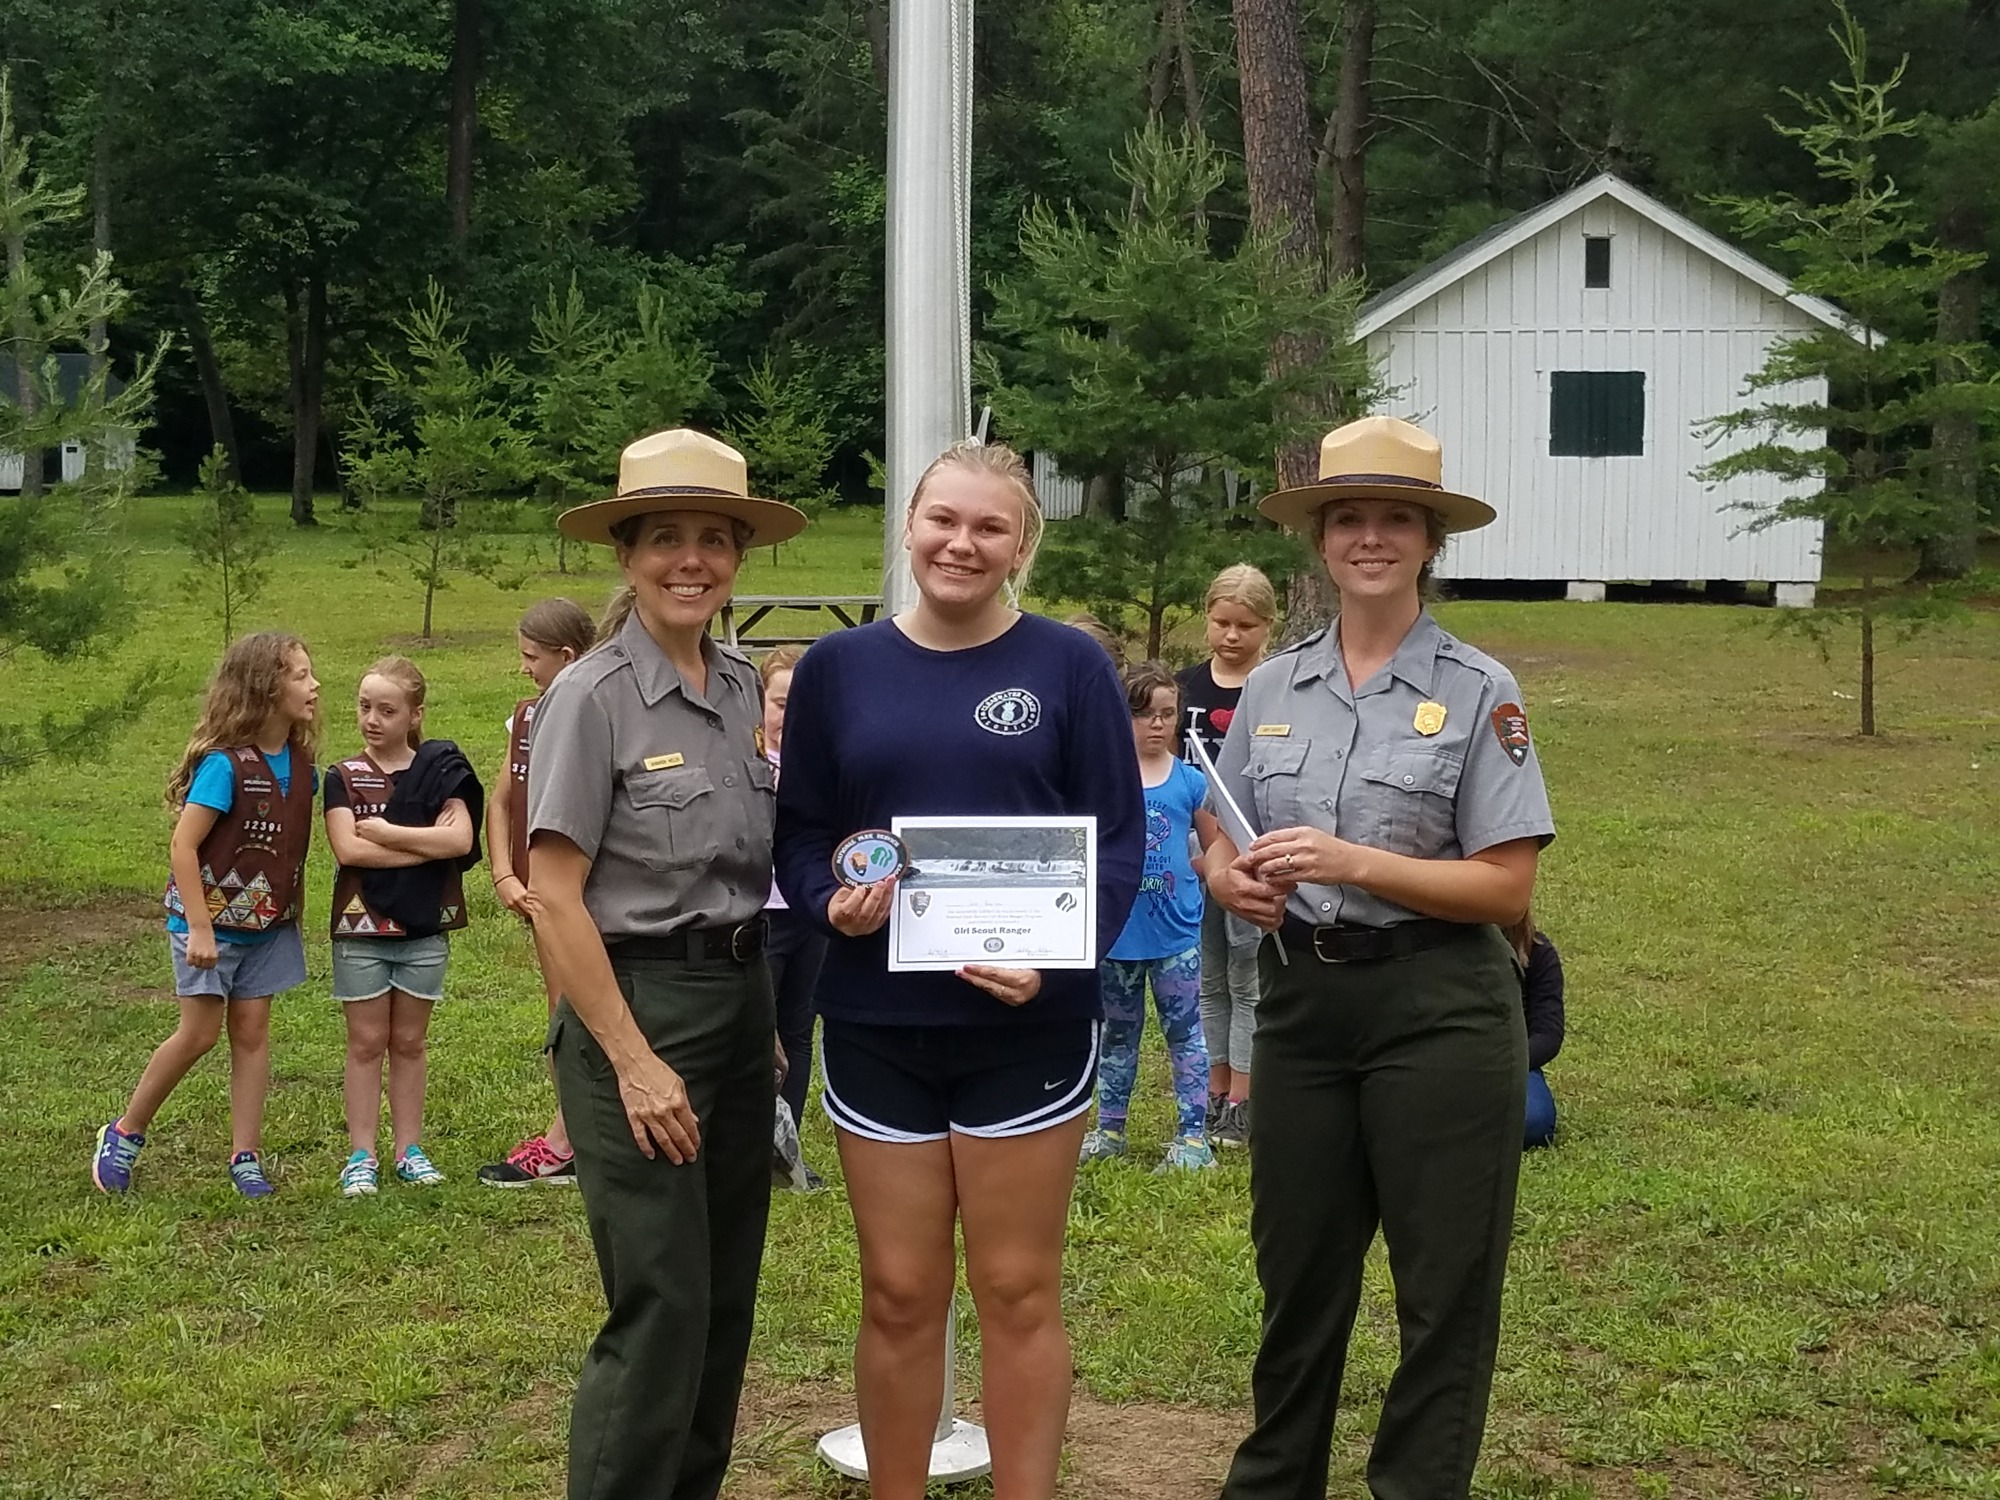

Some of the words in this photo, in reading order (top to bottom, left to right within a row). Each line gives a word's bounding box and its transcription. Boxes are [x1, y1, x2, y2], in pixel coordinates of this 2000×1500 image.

[1185, 706, 1207, 733] I
[971, 926, 997, 934] Scout
[999, 926, 1031, 935] Ranger
